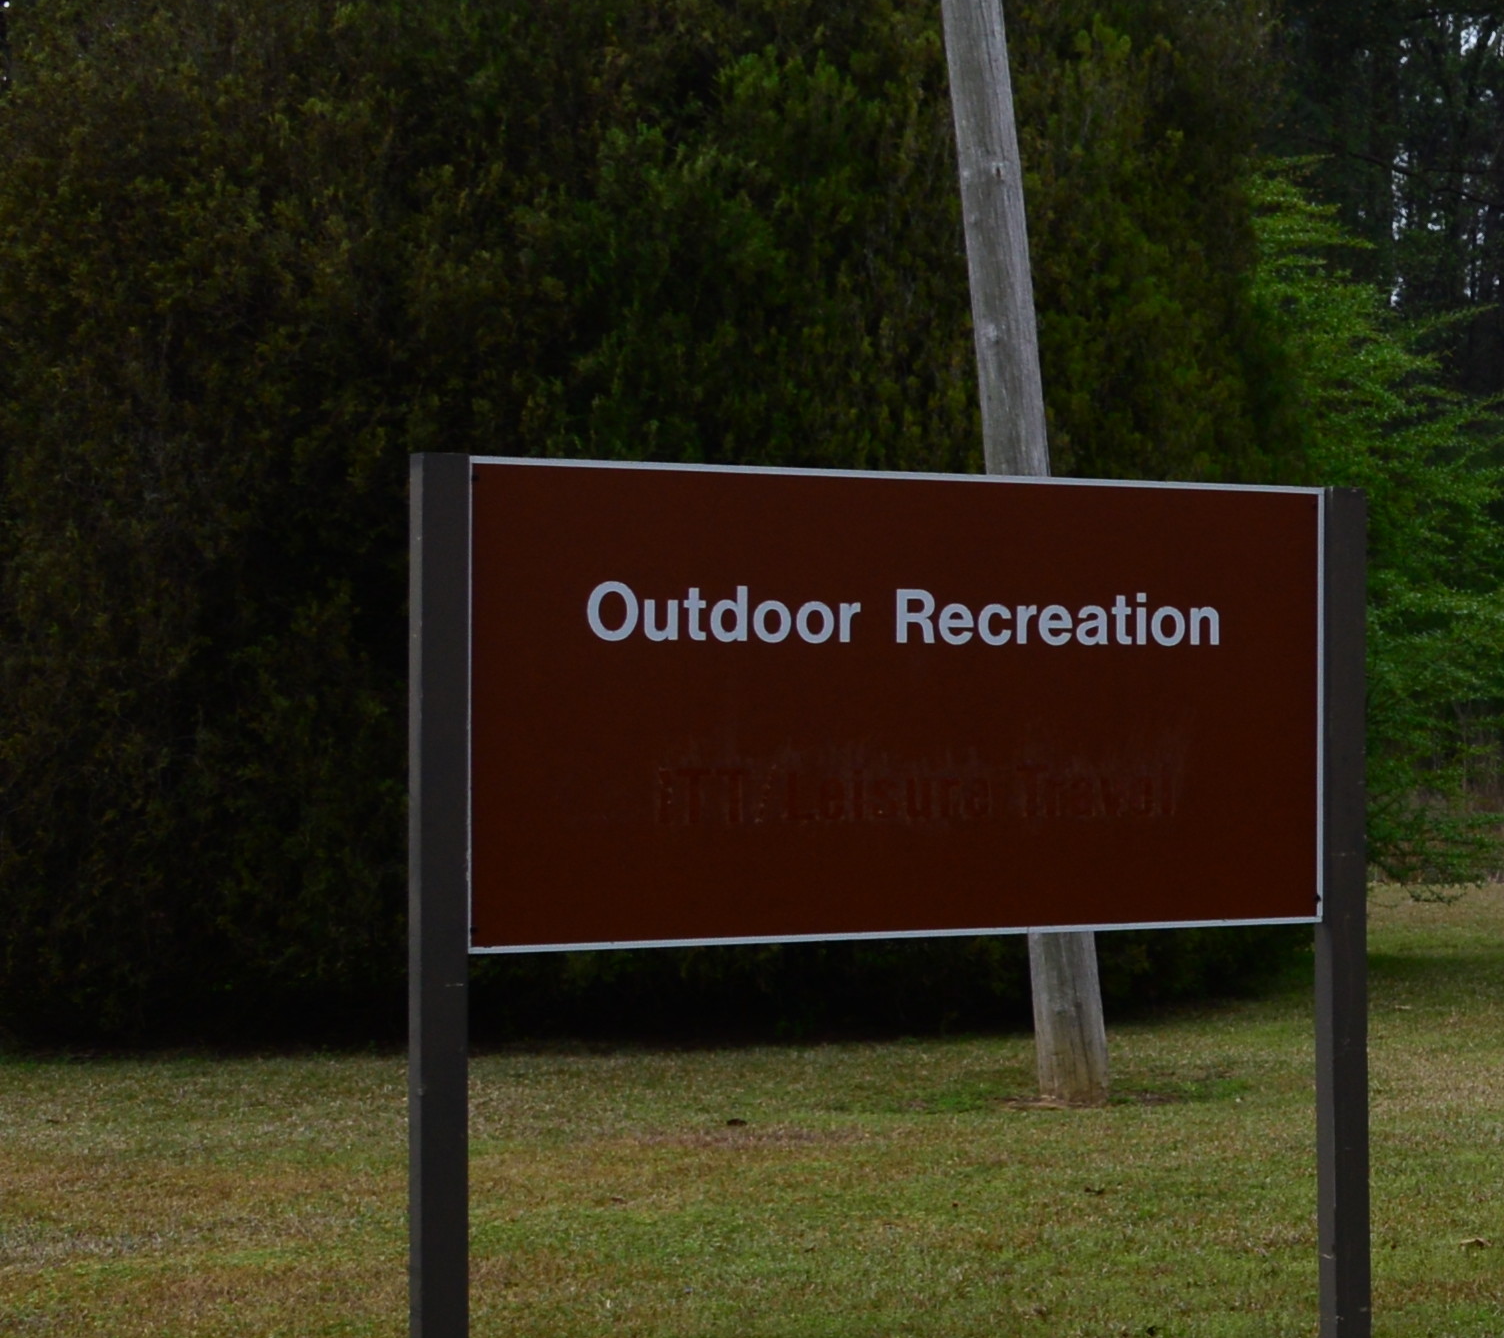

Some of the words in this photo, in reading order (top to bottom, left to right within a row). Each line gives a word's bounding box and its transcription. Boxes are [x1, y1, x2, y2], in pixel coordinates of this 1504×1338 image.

[587, 580, 861, 643] Outdoor
[895, 587, 1221, 646] Recreation
[1017, 764, 1176, 819] Travel
